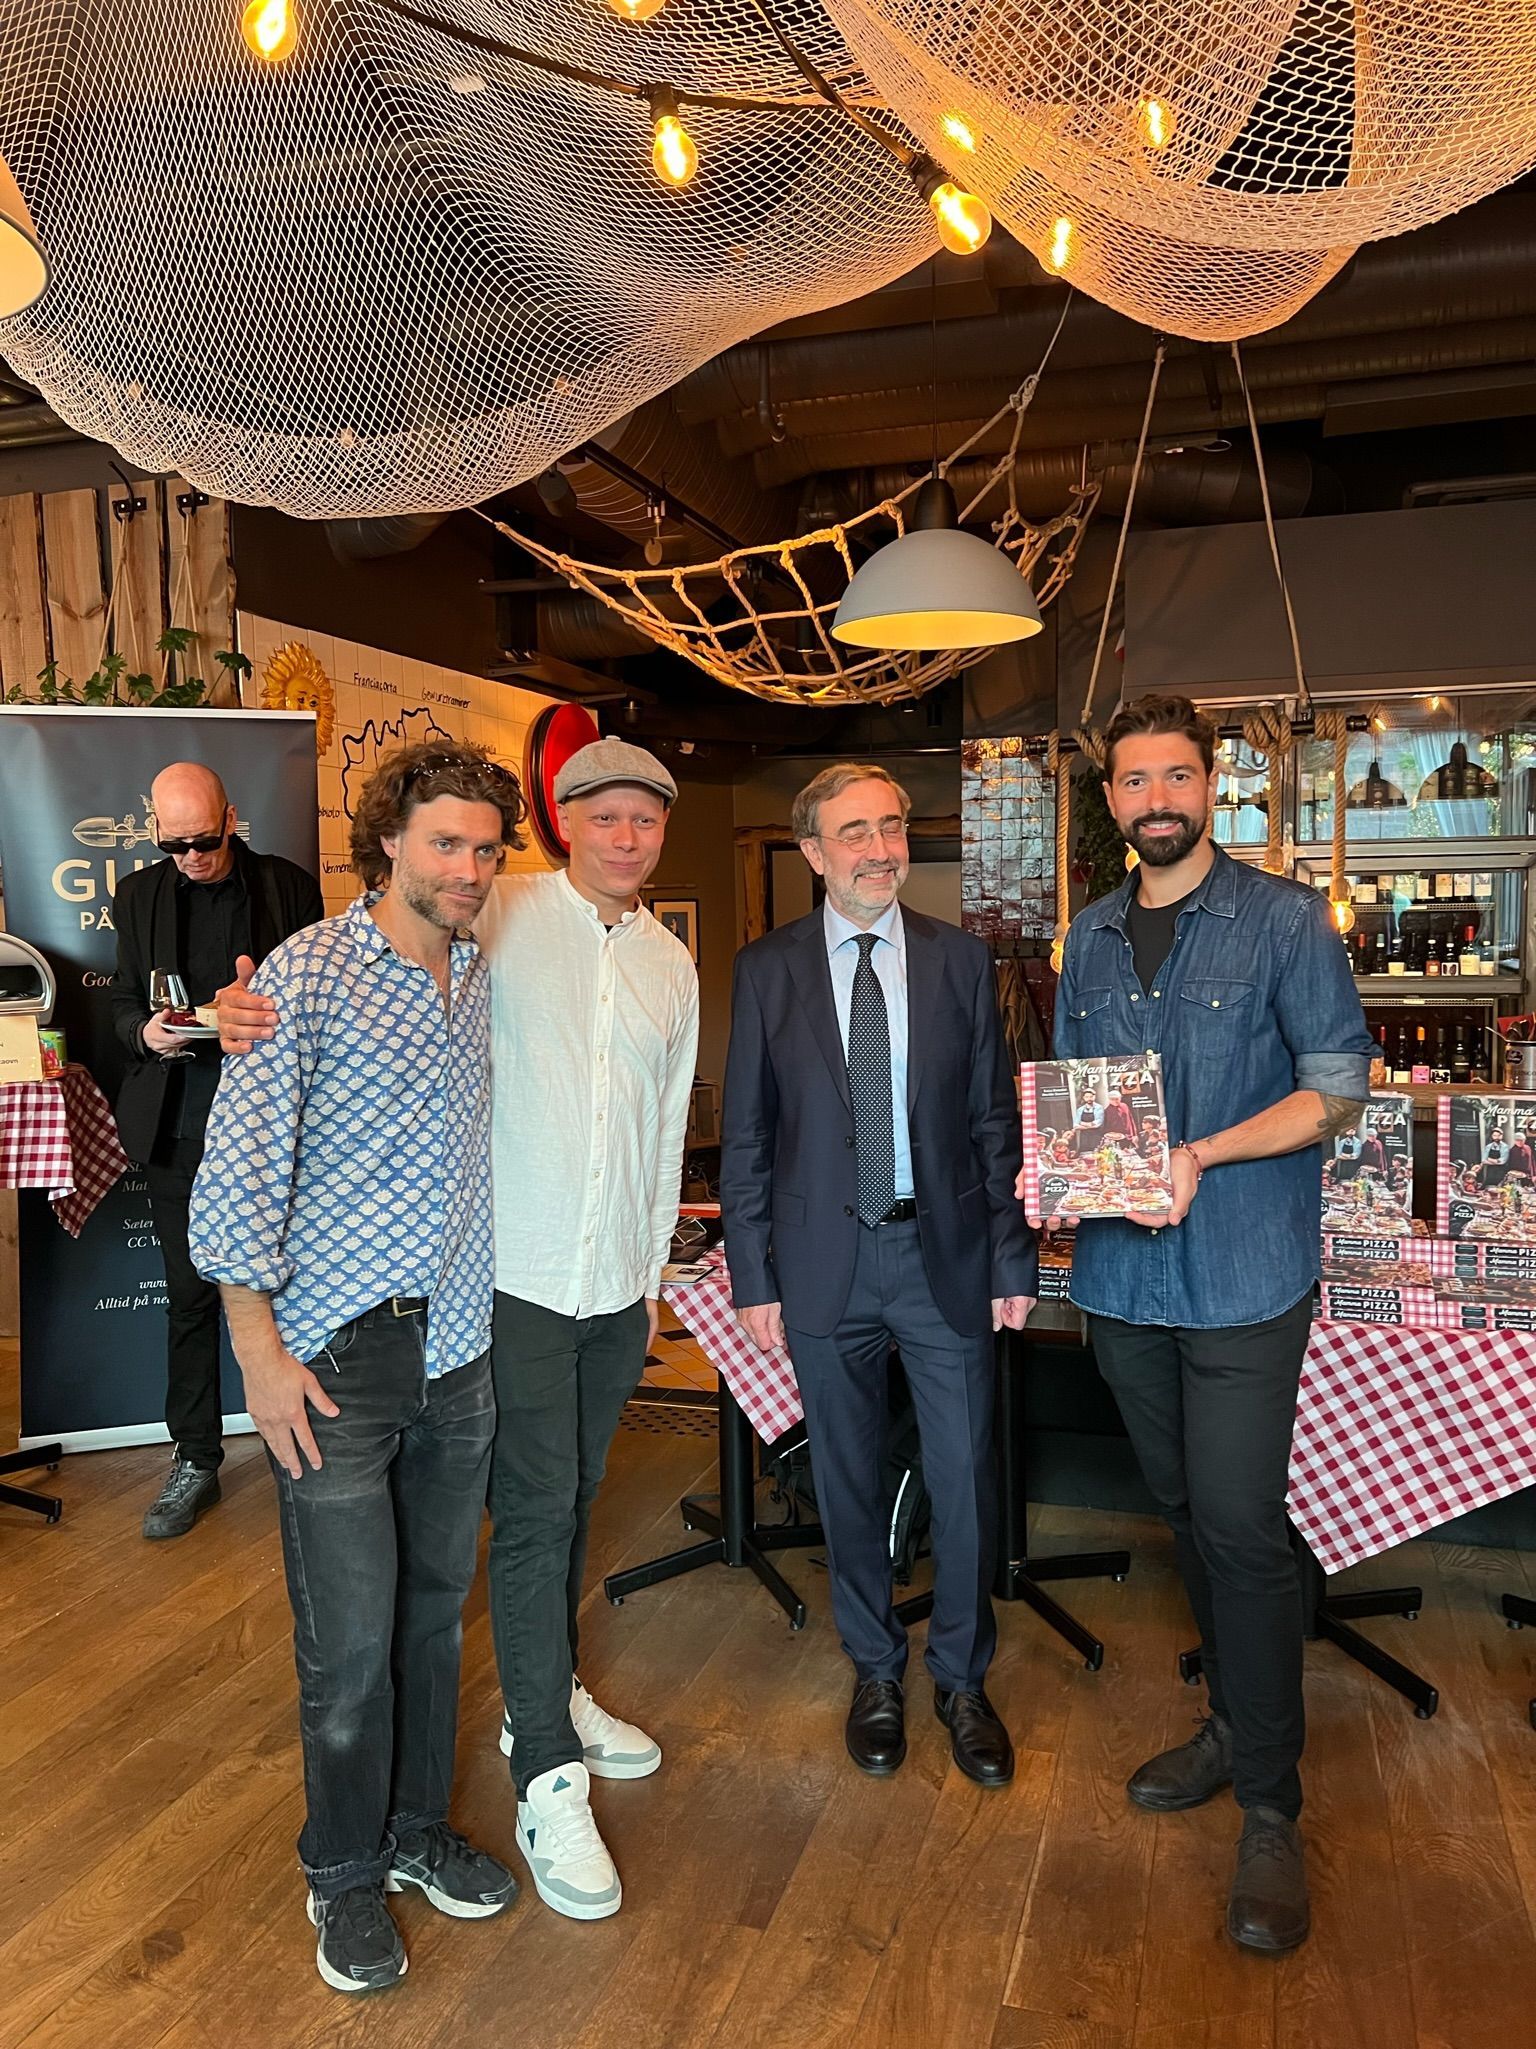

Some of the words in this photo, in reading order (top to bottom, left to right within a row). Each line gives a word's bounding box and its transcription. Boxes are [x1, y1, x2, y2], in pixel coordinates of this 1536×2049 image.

[1071, 1063, 1130, 1078] Mamma
[1087, 1073, 1155, 1089] PIZZA
[127, 1236, 148, 1249] CC
[1363, 1240, 1395, 1249] PIZZA
[1363, 1250, 1395, 1259] PIZZA
[1361, 1289, 1395, 1298] PIZZA
[94, 1296, 130, 1311] Alltid
[132, 1294, 149, 1311] på
[1363, 1301, 1397, 1311] PIZZA
[1363, 1313, 1398, 1322] PIZZA
